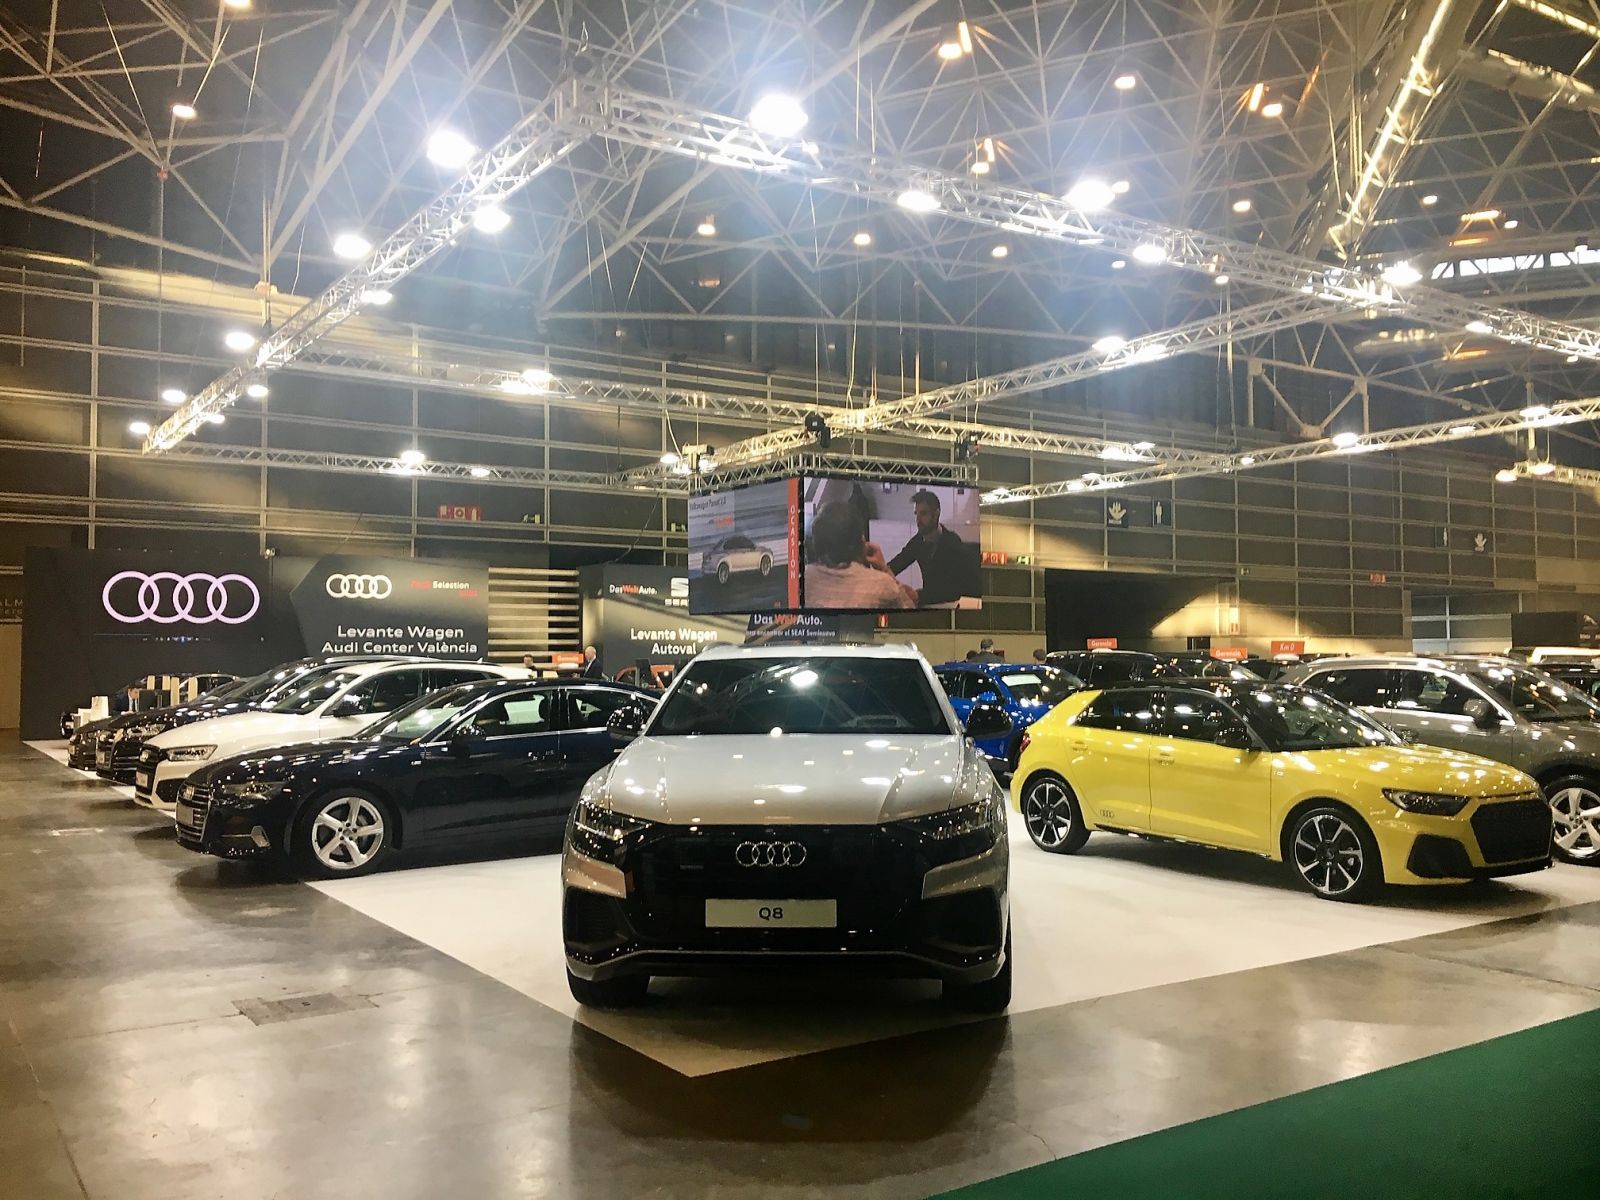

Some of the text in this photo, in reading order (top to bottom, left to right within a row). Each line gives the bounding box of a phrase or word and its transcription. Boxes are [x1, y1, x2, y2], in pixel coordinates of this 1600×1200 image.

[432, 580, 471, 590] Selection
[337, 625, 464, 641] Levante Wagen
[630, 628, 718, 643] Levante Wagen
[321, 641, 478, 654] Audi Center València
[651, 642, 697, 655] Autoval
[758, 907, 784, 921] Q8
